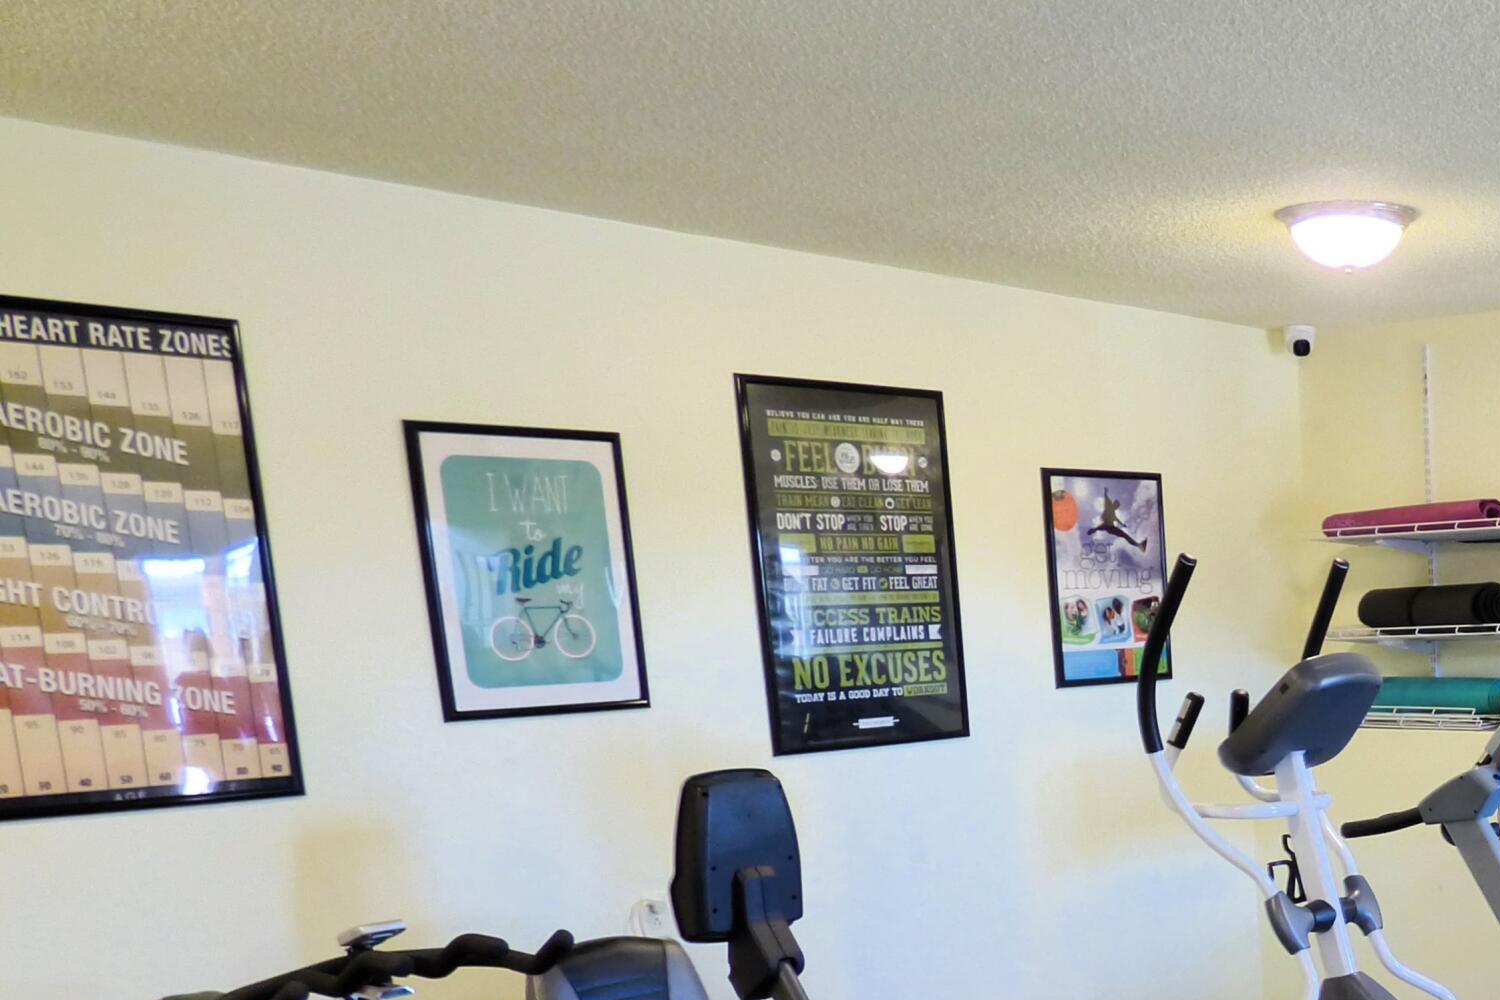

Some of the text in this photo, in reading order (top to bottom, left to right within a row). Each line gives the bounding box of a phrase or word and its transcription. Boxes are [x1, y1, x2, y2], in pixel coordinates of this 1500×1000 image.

[0, 313, 232, 358] HEART RATE ZONES
[119, 428, 190, 466] ZONE
[783, 440, 838, 474] FEEL
[485, 472, 570, 515] I WANT
[822, 477, 838, 490] USE
[841, 478, 865, 491] THEM
[868, 479, 880, 491] OR
[883, 478, 904, 492] LOSE
[905, 480, 929, 493] THEM
[113, 510, 181, 544] ZONE
[519, 520, 545, 541] to
[777, 513, 845, 531] DON'T STOP
[880, 515, 907, 531] STOP
[820, 537, 833, 551] NO
[836, 537, 859, 551] PAIN
[862, 537, 875, 551] NO
[487, 537, 584, 596] Ride
[876, 556, 903, 564] BETTER
[812, 577, 827, 591] FAT
[842, 577, 876, 590] GET FIT
[889, 575, 938, 590] FEEL GREAT
[1063, 563, 1153, 594] moving
[875, 606, 942, 625] TRAINS
[810, 625, 925, 645] FAILURE COMPLAINS
[793, 650, 947, 690] NO EXCUSES
[171, 686, 237, 715] ZONE
[795, 693, 824, 703] TODAY
[839, 691, 847, 701] A
[848, 689, 870, 700] GOOD
[873, 688, 890, 699] DAY
[892, 687, 904, 697] TO
